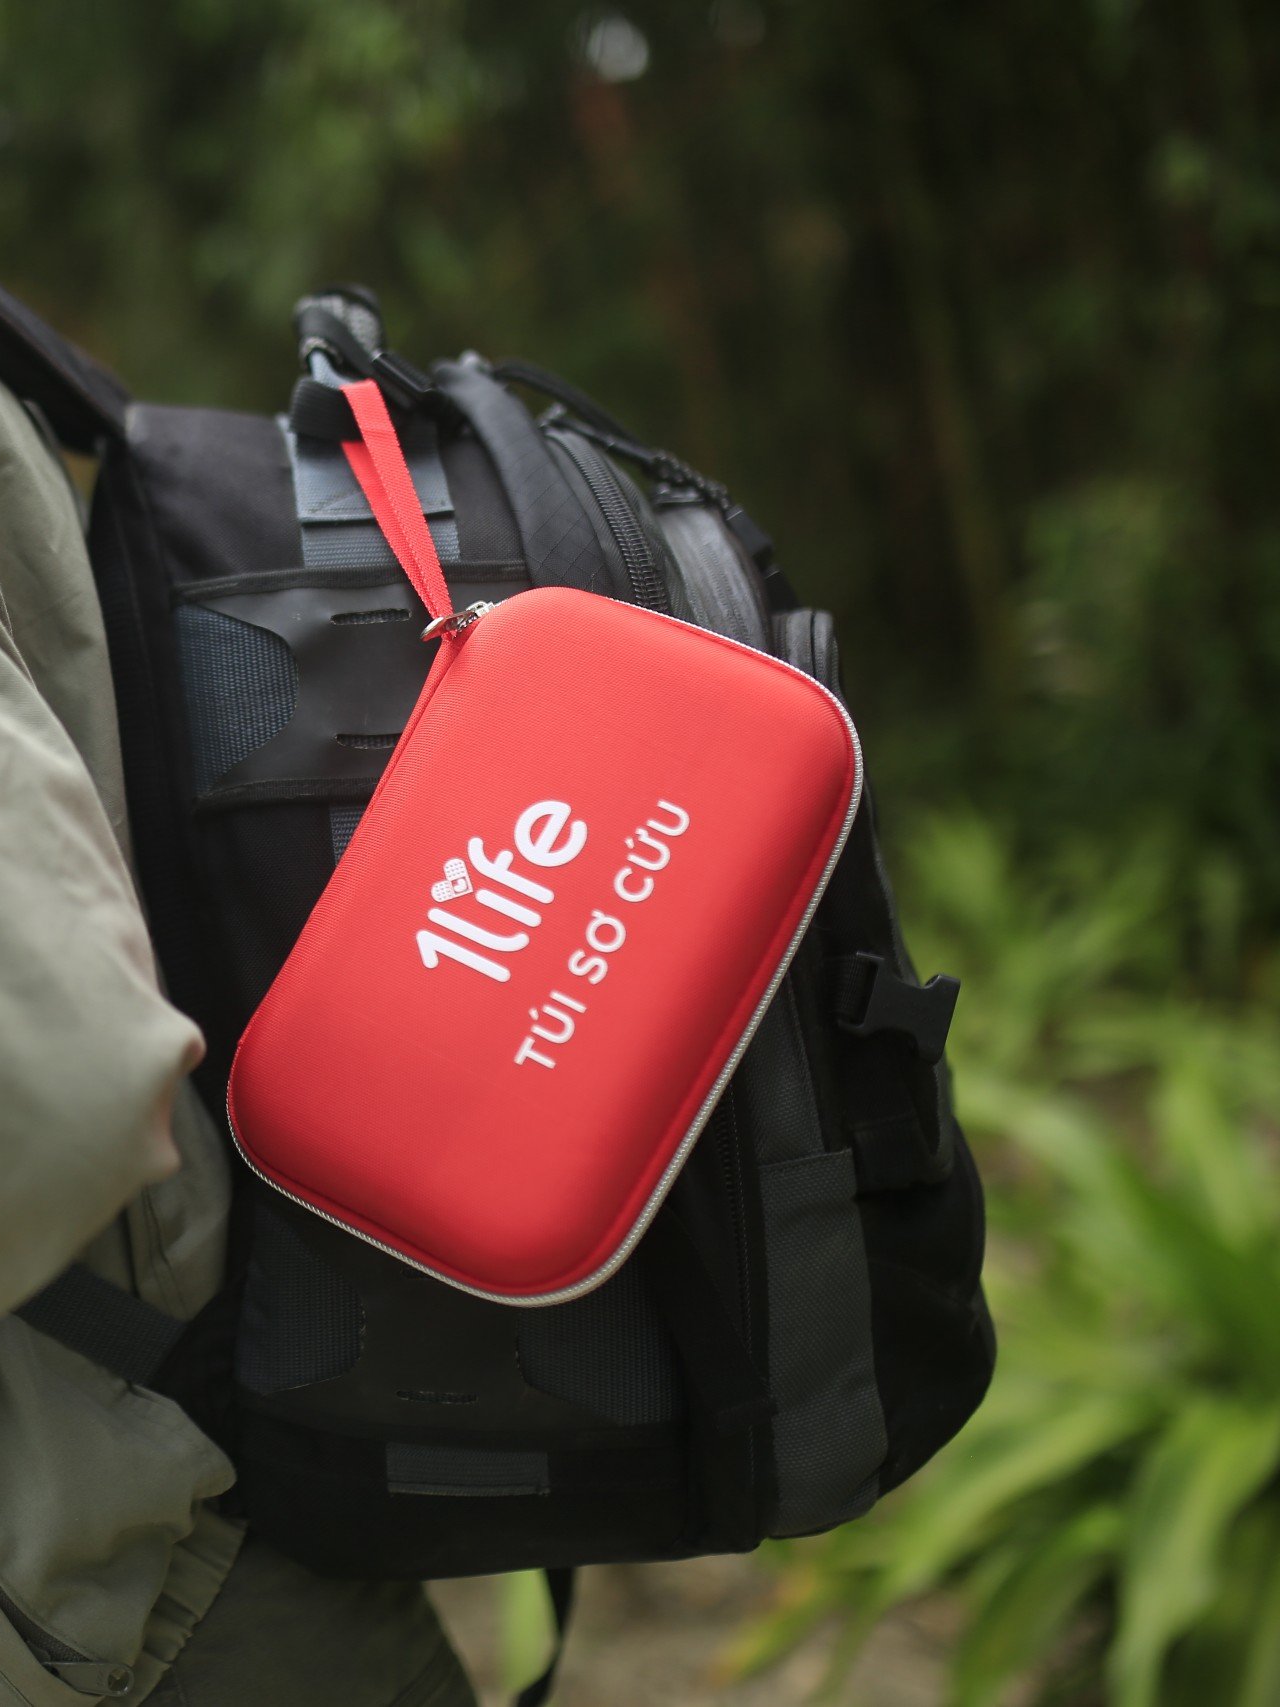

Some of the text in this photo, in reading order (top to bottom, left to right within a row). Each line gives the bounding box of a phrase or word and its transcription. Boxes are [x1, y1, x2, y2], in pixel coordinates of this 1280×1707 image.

[514, 800, 690, 1069] TÚI SƠ CỨU
